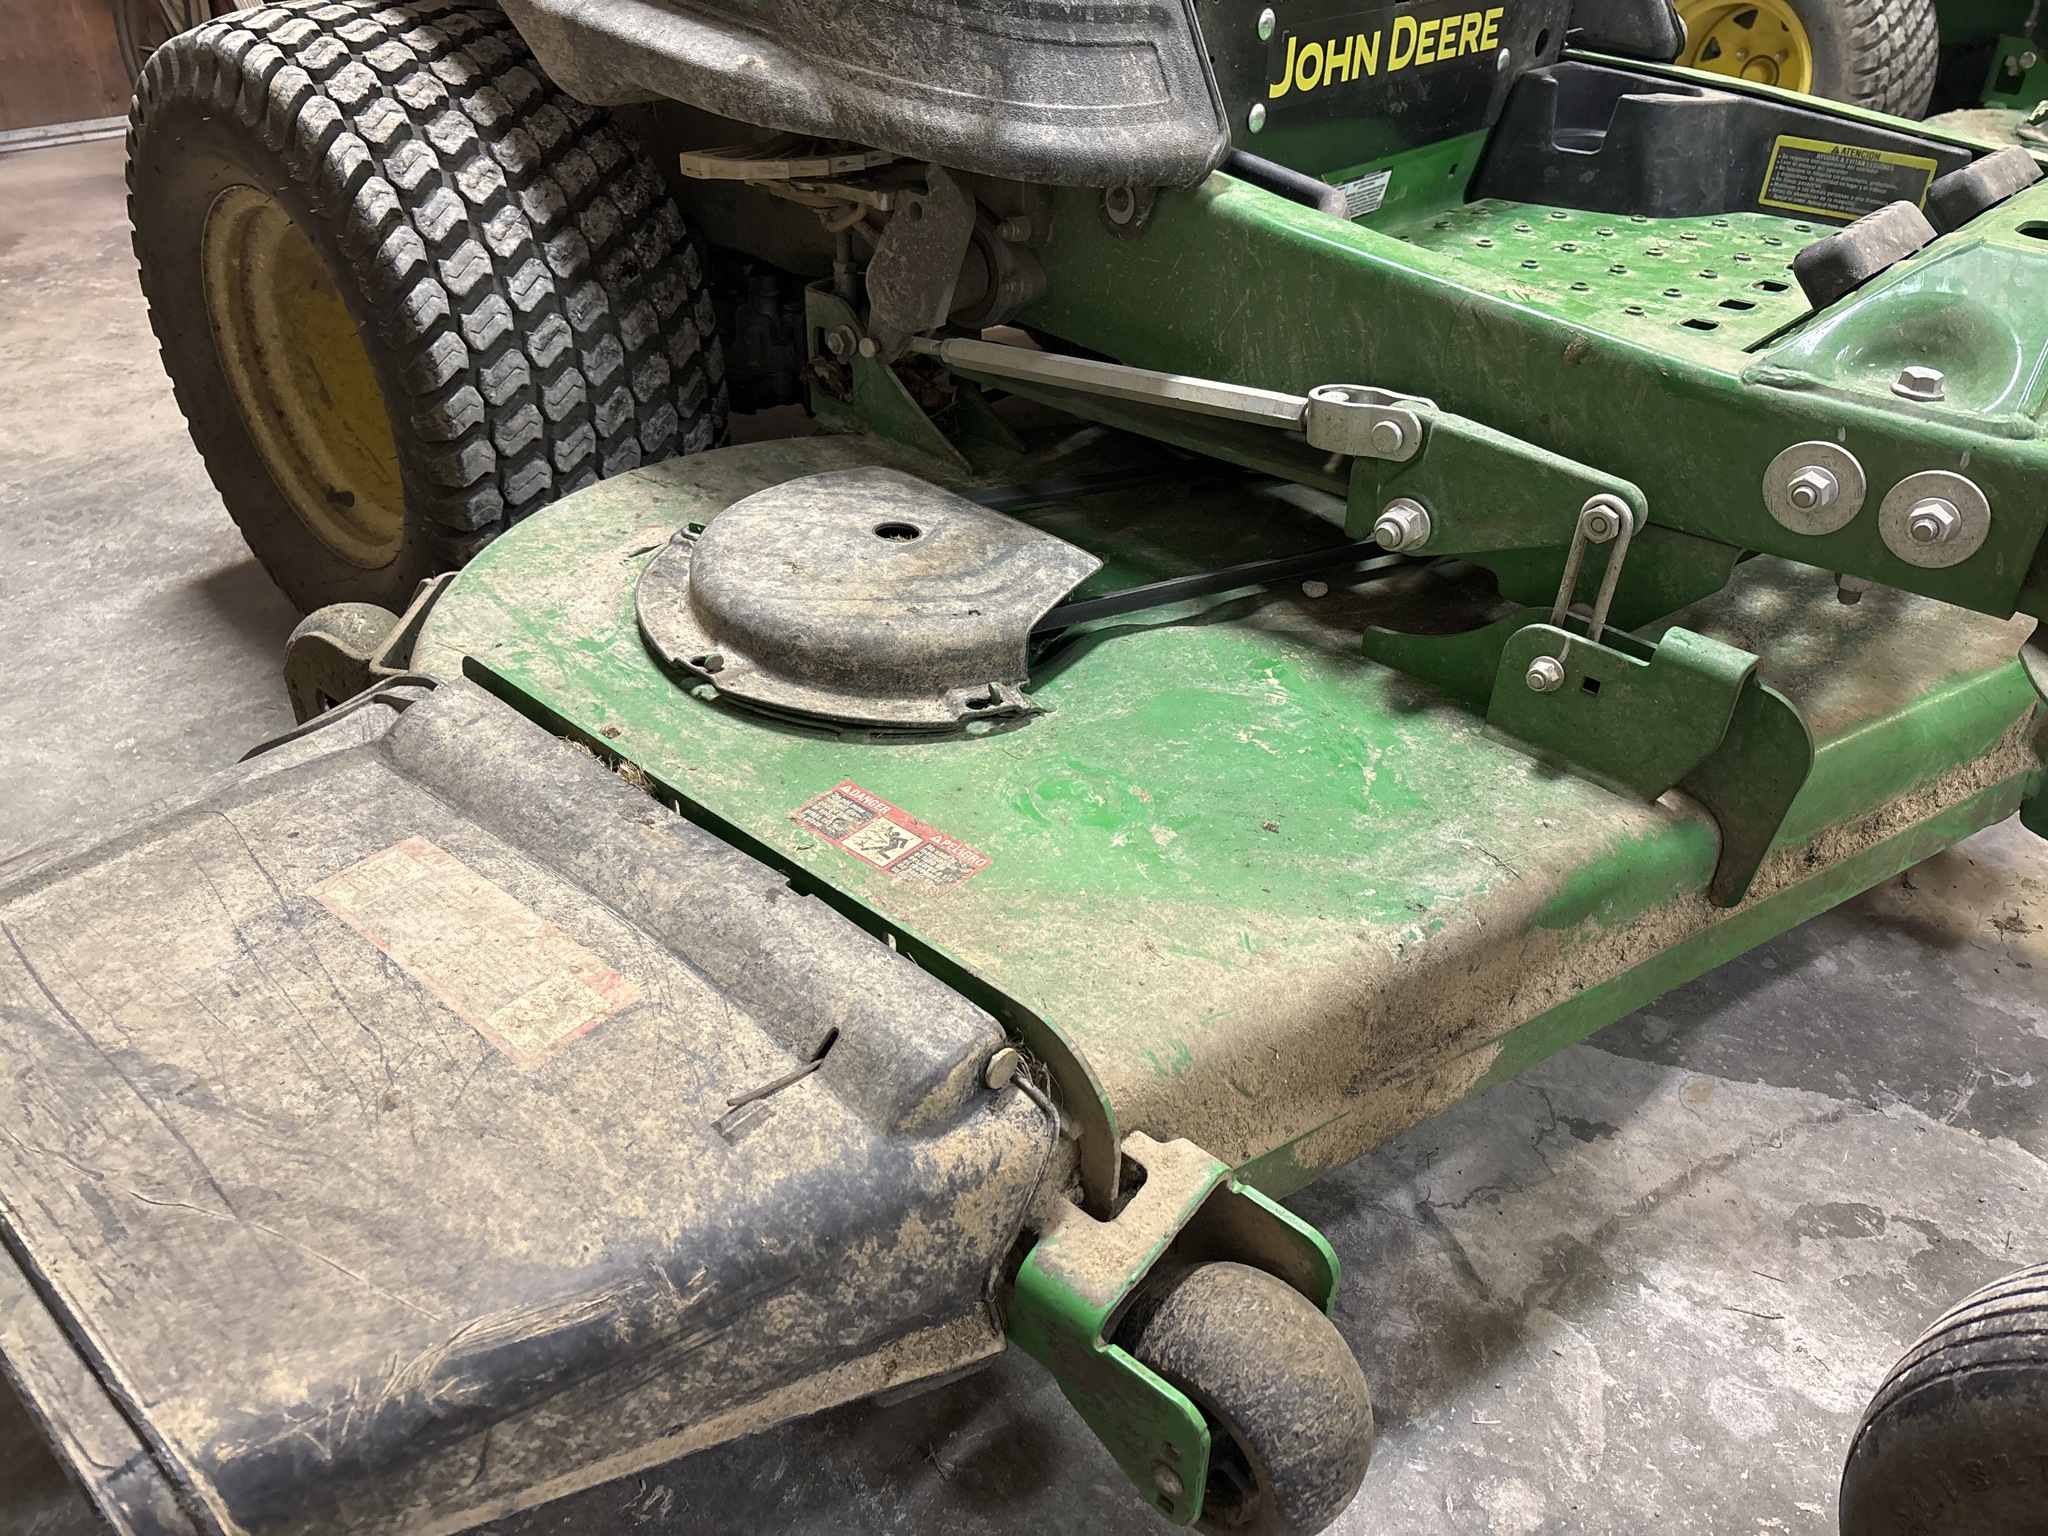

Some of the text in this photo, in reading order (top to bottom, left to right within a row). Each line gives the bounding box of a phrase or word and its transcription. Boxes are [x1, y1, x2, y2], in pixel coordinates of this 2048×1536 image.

[1268, 7, 1504, 99] JOHN DEERE
[1840, 146, 1881, 160] ATENCION
[847, 788, 892, 814] DANGER
[849, 803, 866, 813] mow
[938, 838, 988, 867] PELIGRO
